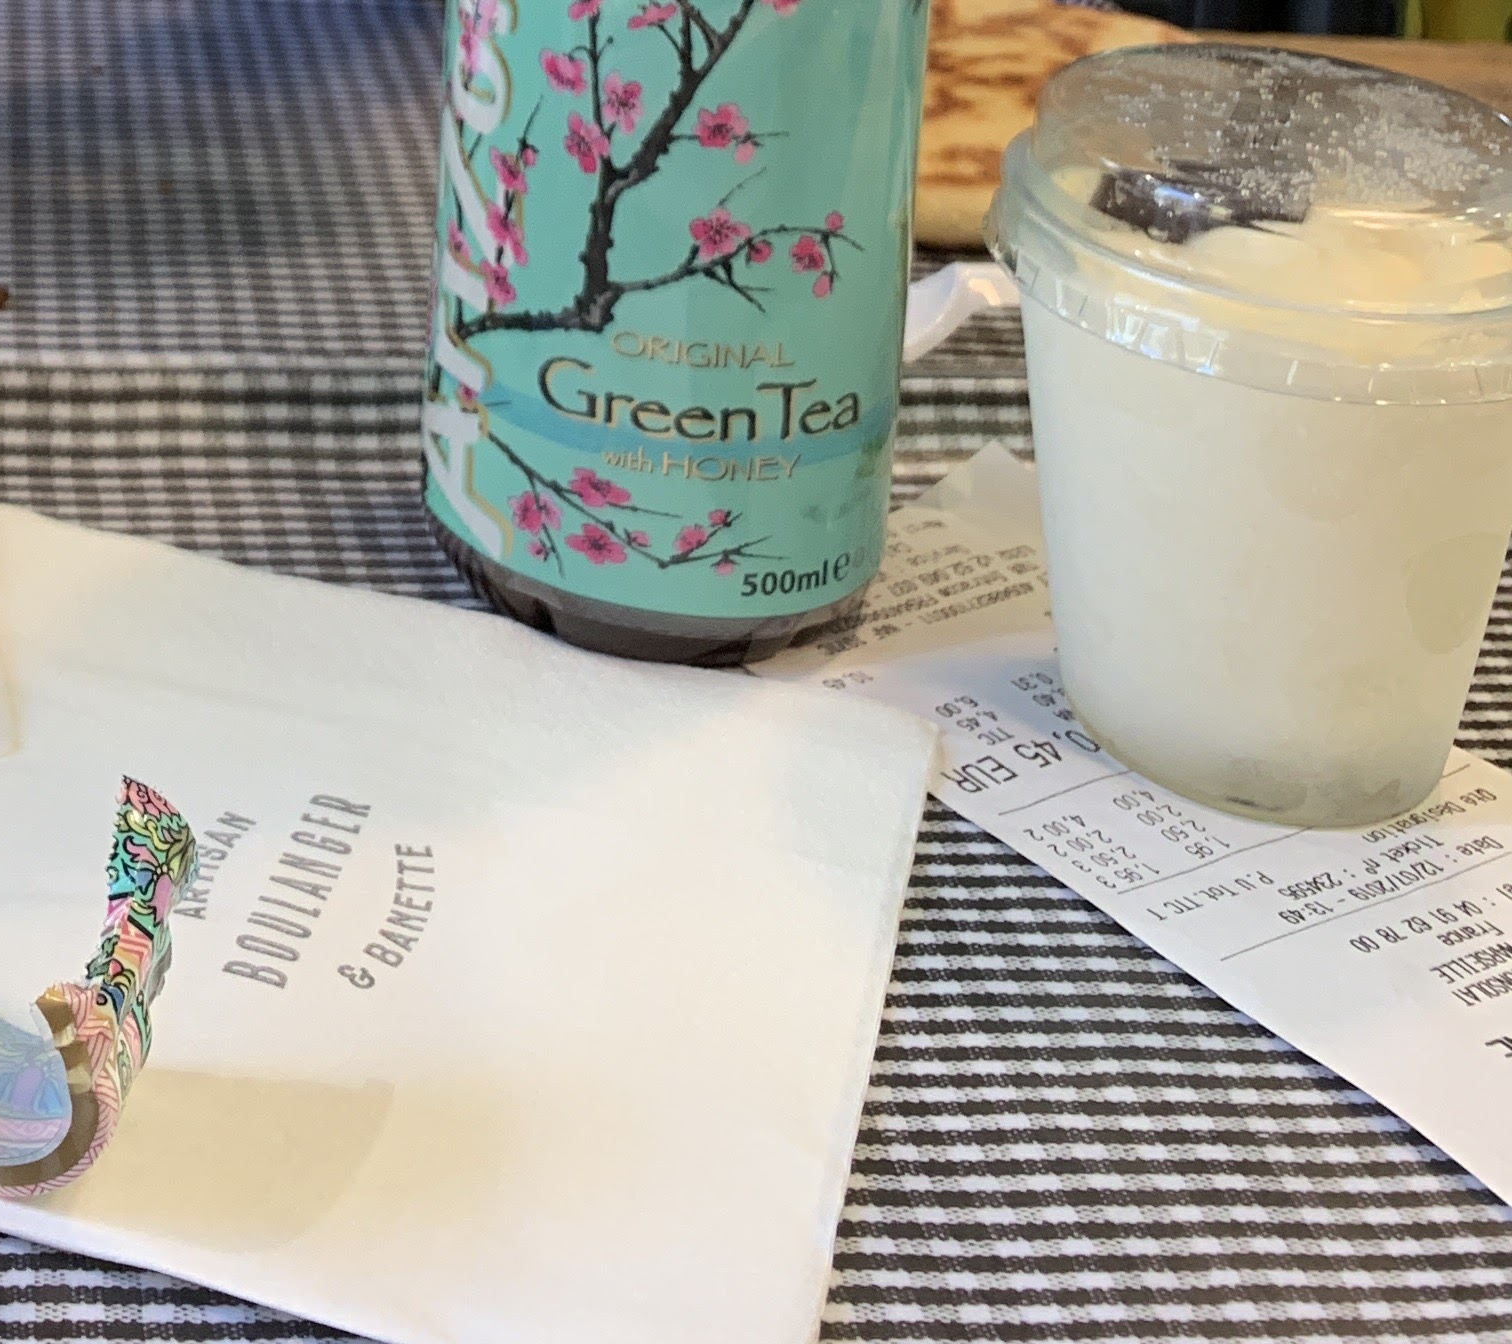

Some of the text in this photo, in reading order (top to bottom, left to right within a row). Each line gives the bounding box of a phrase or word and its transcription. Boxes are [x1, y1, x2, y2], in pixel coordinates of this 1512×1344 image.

[610, 330, 797, 369] ORIGINAL
[602, 446, 801, 483] with HONEY
[978, 727, 1014, 745] TTC
[941, 730, 1100, 793] 0,45 EUR
[1023, 791, 1154, 841] 4,00 4,00 2
[1047, 805, 1181, 857] 2,00 2,00 2
[1072, 820, 1205, 872] 2,50 2,50 3
[1096, 837, 1230, 887] 1,95 1,95 3
[1380, 835, 1443, 863] Ticket
[1456, 836, 1503, 856] Date
[221, 793, 372, 990] BOULANGER
[1348, 860, 1444, 900] 12/07/2019
[336, 842, 435, 990] & BANETTE
[1278, 901, 1333, 924] 13:49
[1402, 917, 1430, 933] 62
[1428, 908, 1456, 924] 91
[1453, 901, 1482, 917] 04
[1350, 936, 1379, 953] 00
[1375, 926, 1405, 943] 78
[1437, 921, 1504, 946] France
